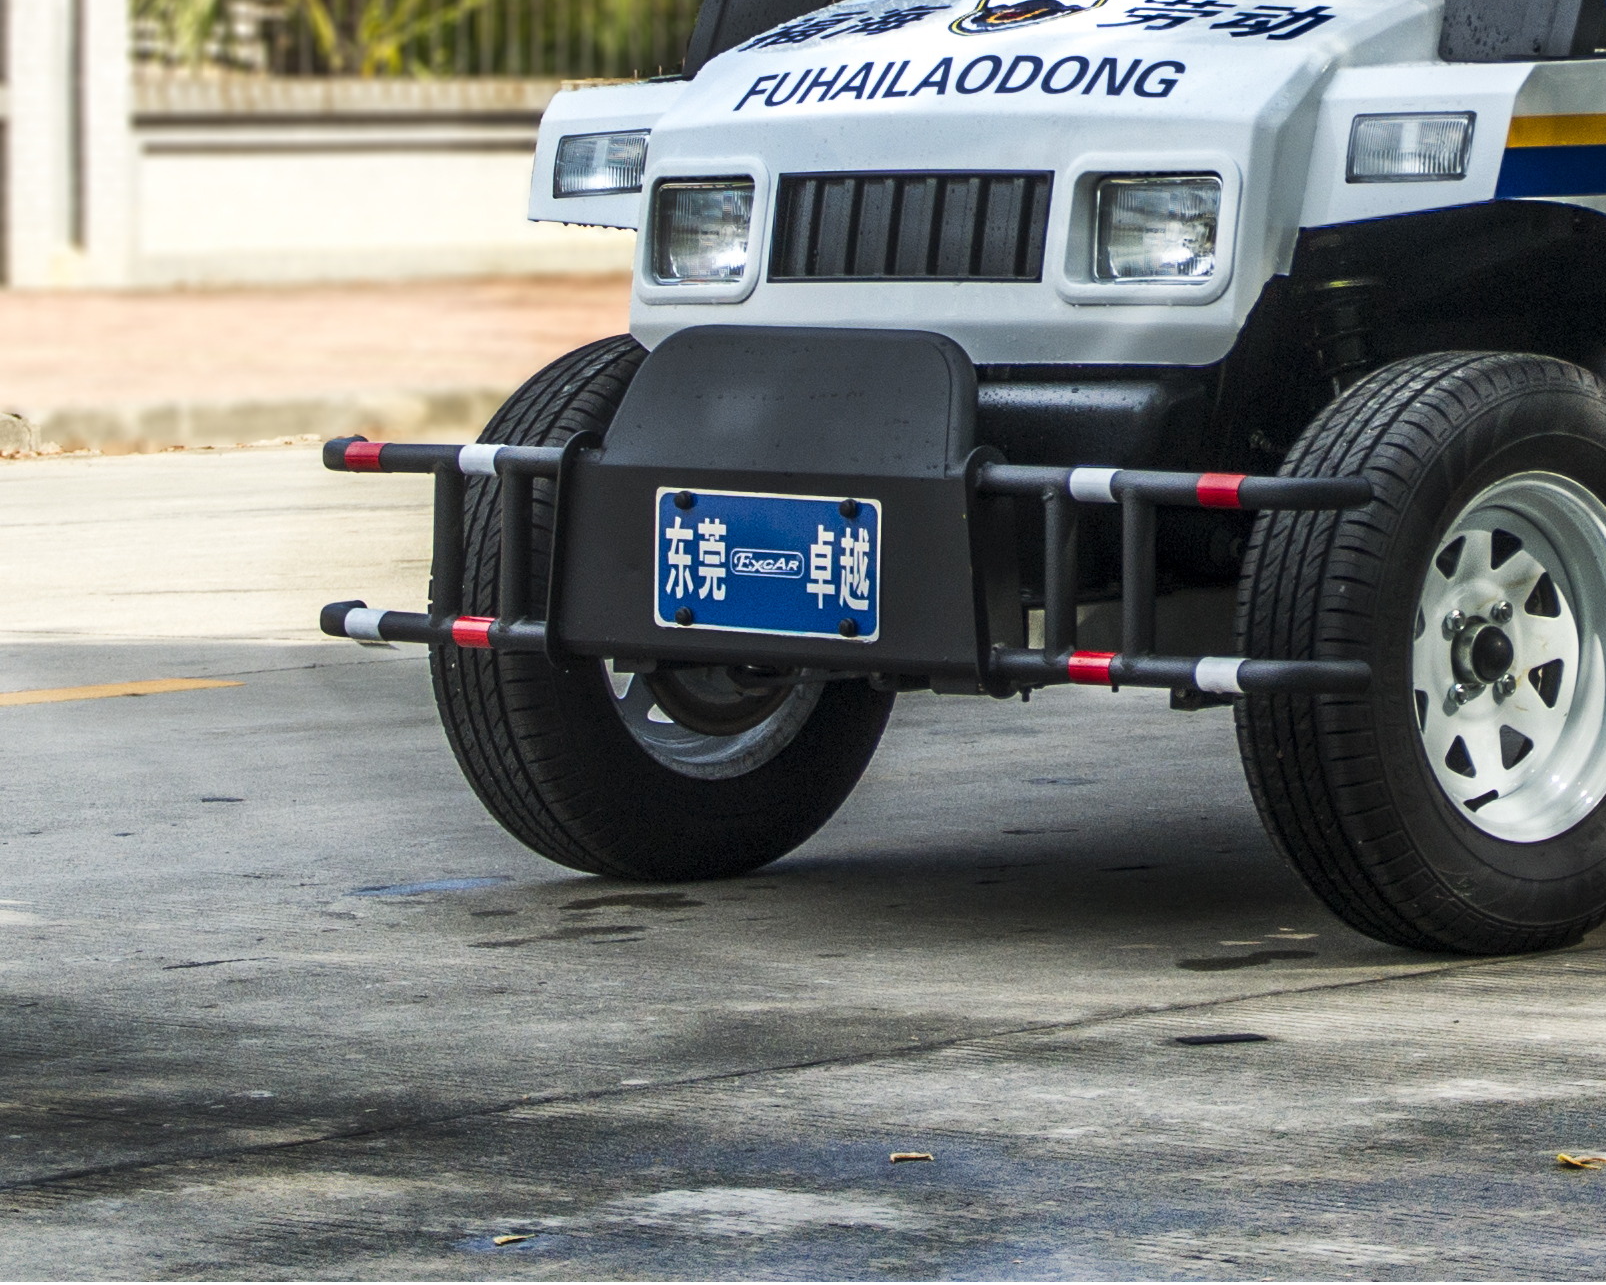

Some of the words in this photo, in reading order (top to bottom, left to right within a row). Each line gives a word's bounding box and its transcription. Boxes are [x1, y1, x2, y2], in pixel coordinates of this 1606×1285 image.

[734, 55, 1187, 111] FUHAILAODONG
[665, 516, 727, 601] 东莞
[806, 524, 870, 611] 卓越
